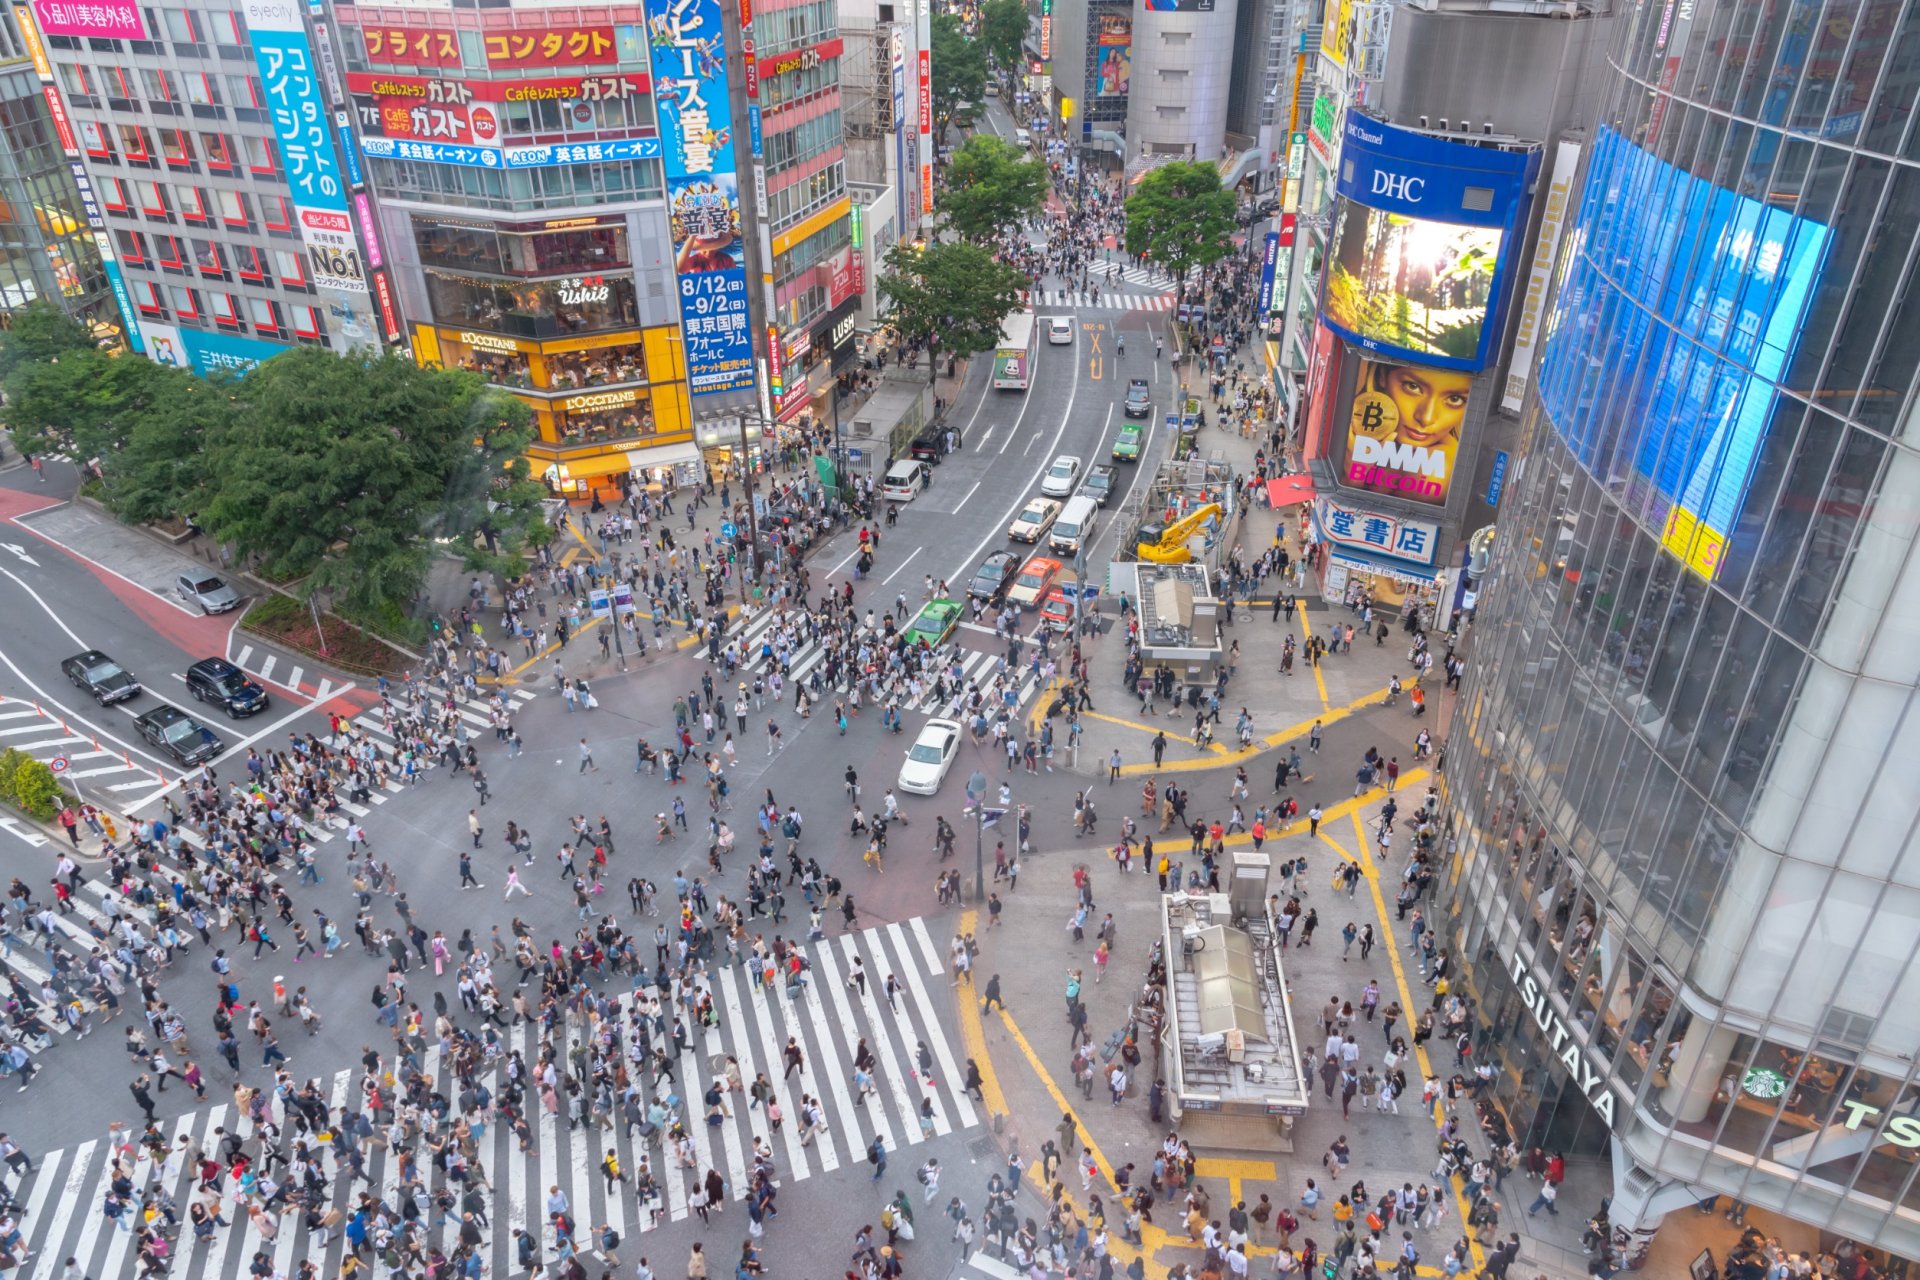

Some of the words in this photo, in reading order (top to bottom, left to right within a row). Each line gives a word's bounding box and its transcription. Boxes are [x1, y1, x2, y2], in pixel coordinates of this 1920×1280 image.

[48, 3, 136, 29] 品川美容外科
[250, 4, 292, 22] eyecity
[364, 31, 459, 59] プライス
[484, 31, 612, 60] コンタクト
[801, 48, 820, 71] ガスト
[427, 79, 473, 105] ガスト
[581, 77, 637, 101] ガスト
[260, 47, 314, 196] アイシティ
[286, 48, 338, 197] コンタクトの
[359, 107, 380, 125] 7F
[384, 108, 409, 122] Café
[410, 107, 466, 138] ガスト
[475, 122, 495, 131] ガスト
[1347, 123, 1357, 136] DHC
[1359, 128, 1383, 145] Channel
[365, 140, 391, 154] AEON
[398, 142, 478, 163] 英会話イーオン
[482, 152, 495, 163] 6F
[511, 151, 547, 165] AEON
[555, 142, 658, 163] 英会話イーオン
[1371, 169, 1425, 202] DHC
[307, 213, 347, 229] 当ビル5階
[313, 232, 345, 245] 利用者数
[307, 243, 364, 281] No.1
[315, 276, 365, 290] コンタクトショップ
[681, 275, 745, 297] 8/12(日)
[558, 286, 609, 305] Ushi8
[1516, 276, 1544, 348] neon
[685, 313, 747, 335] 東京国際
[832, 313, 855, 344] LUSH
[461, 332, 517, 351] L'OCCITANE
[687, 330, 748, 352] フォーラム
[1363, 340, 1378, 349] DHC
[566, 391, 636, 410] L'OCCITANE
[1352, 436, 1445, 479] DMM
[1350, 462, 1442, 497] Bitcoin
[1511, 953, 1614, 1129] TSUTAYA
